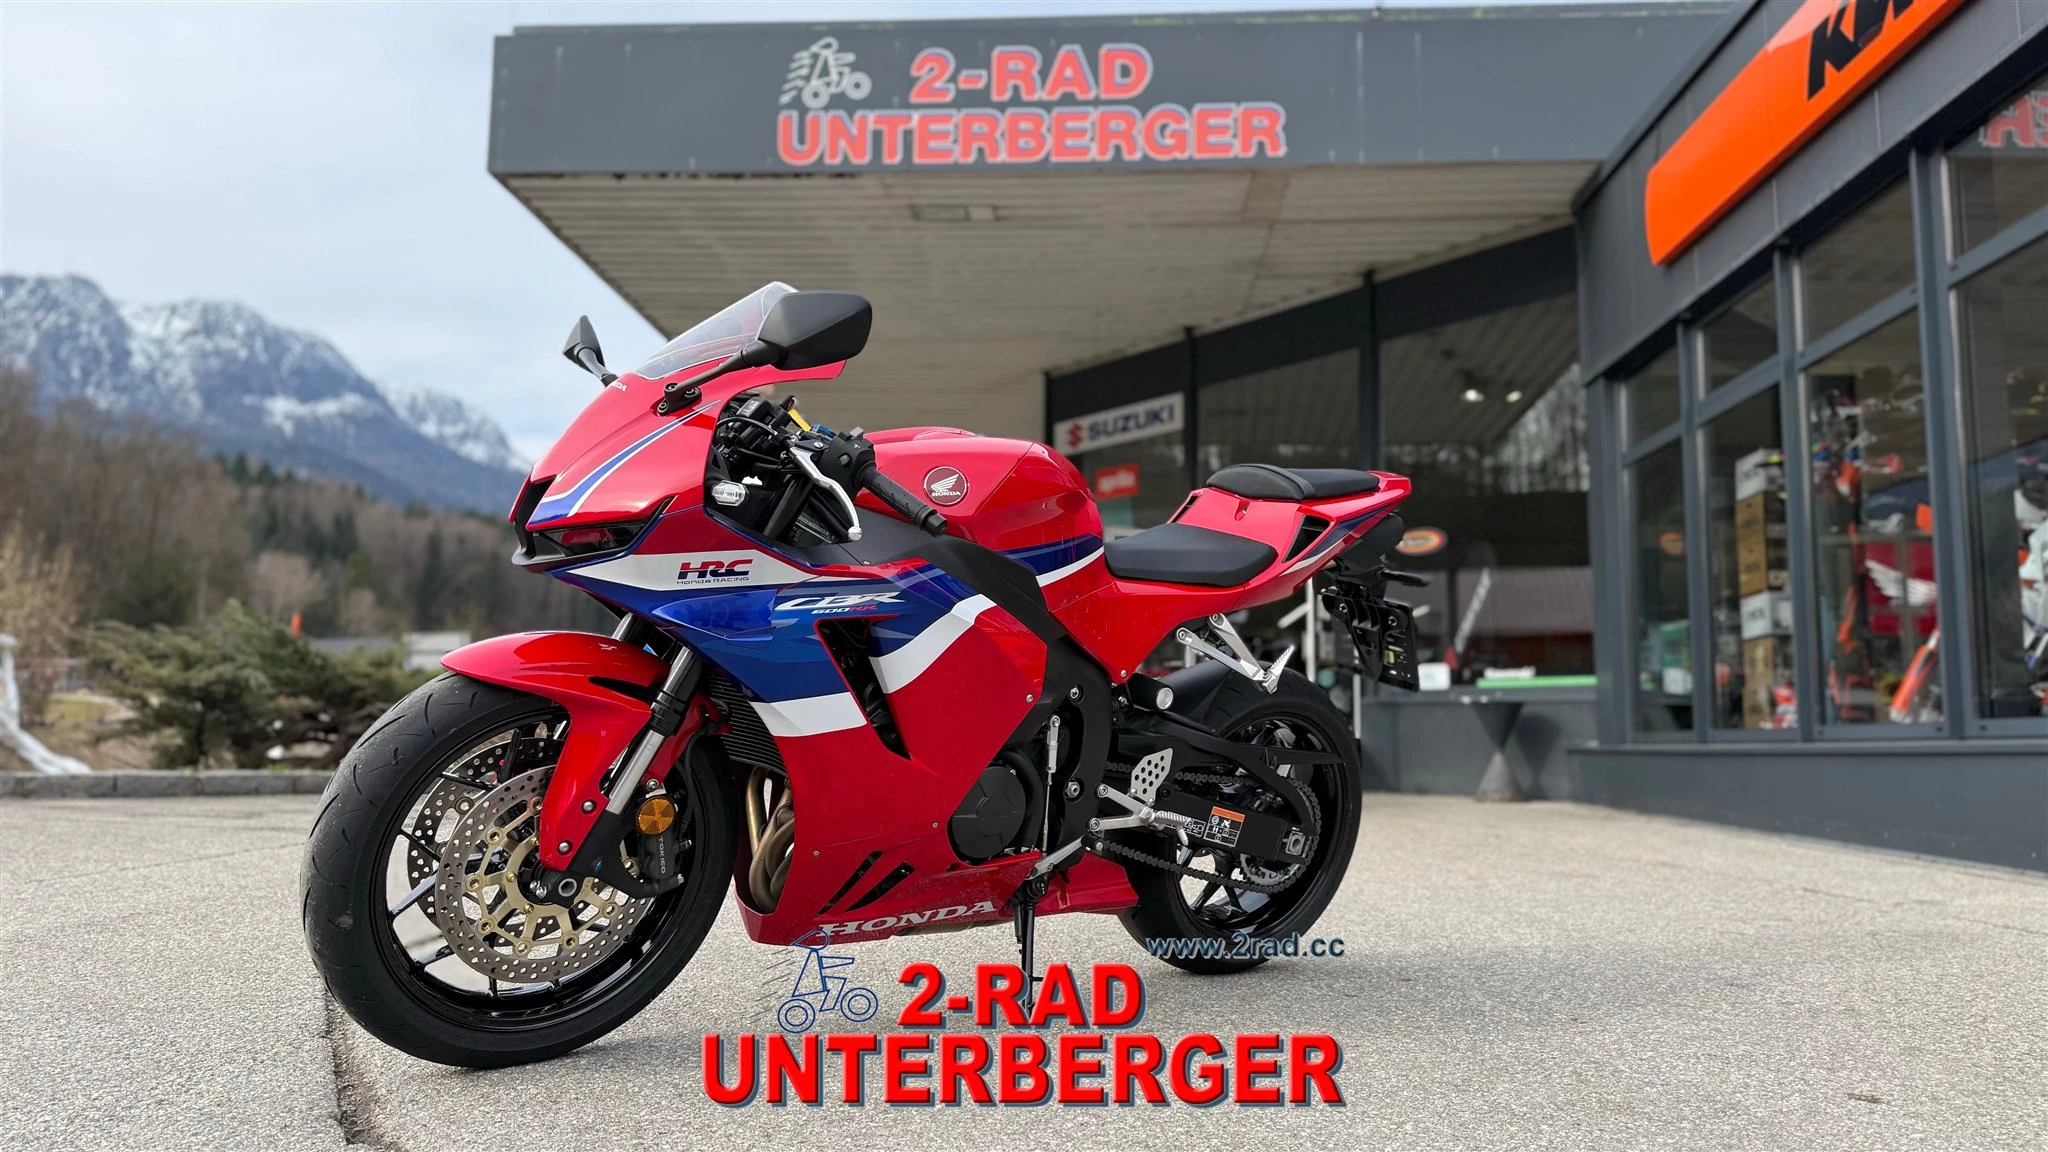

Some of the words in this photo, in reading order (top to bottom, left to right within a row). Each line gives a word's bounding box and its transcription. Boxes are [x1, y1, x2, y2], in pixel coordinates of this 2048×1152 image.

[909, 43, 1154, 104] 2-RAD
[777, 102, 1287, 166] UNTERBERGER
[1087, 402, 1175, 441] SUZUKI
[677, 558, 754, 580] HRC
[774, 591, 906, 611] CBR
[659, 836, 667, 874] TOKICO
[815, 900, 997, 937] HONDA
